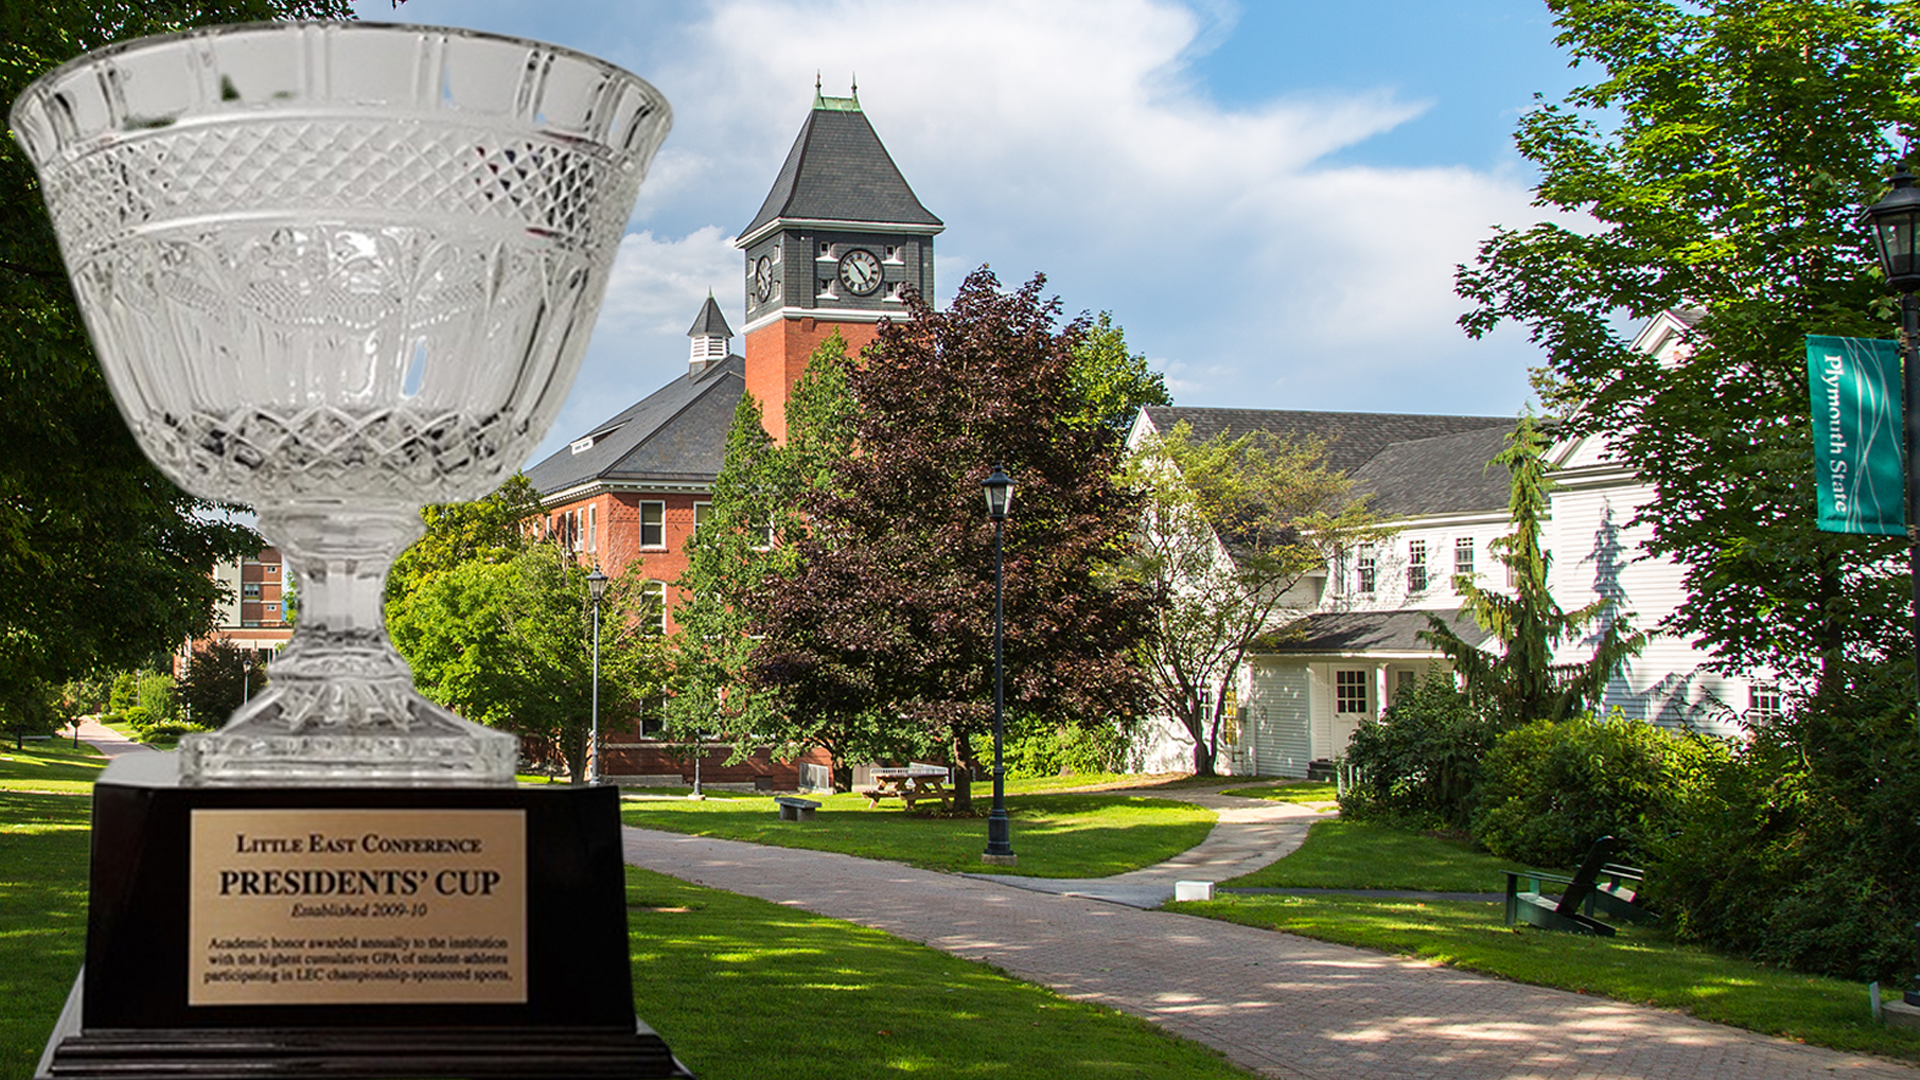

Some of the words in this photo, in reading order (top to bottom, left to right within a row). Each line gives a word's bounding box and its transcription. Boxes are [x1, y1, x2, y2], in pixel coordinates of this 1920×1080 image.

[1821, 354, 1846, 454] Plymouth
[1830, 460, 1846, 512] State
[435, 871, 500, 896] CUP
[292, 903, 368, 918] Established
[372, 903, 427, 918] 2009-10
[209, 938, 267, 949] Academic
[272, 938, 304, 949] honor
[309, 938, 357, 949] awarded
[361, 938, 410, 952] annually
[414, 939, 425, 949] to
[428, 938, 445, 949] the
[450, 938, 508, 949] institution
[209, 954, 234, 965] with
[238, 954, 255, 965] the
[260, 954, 300, 968] highest
[305, 954, 368, 965] cumulative
[372, 954, 399, 965] GPA
[402, 954, 414, 965] of
[418, 954, 508, 965] student-athletes
[204, 970, 277, 984] participating
[281, 970, 292, 981] in
[297, 970, 324, 981] LEC
[327, 970, 470, 984] championship-sponsored
[474, 970, 512, 984] sports.
